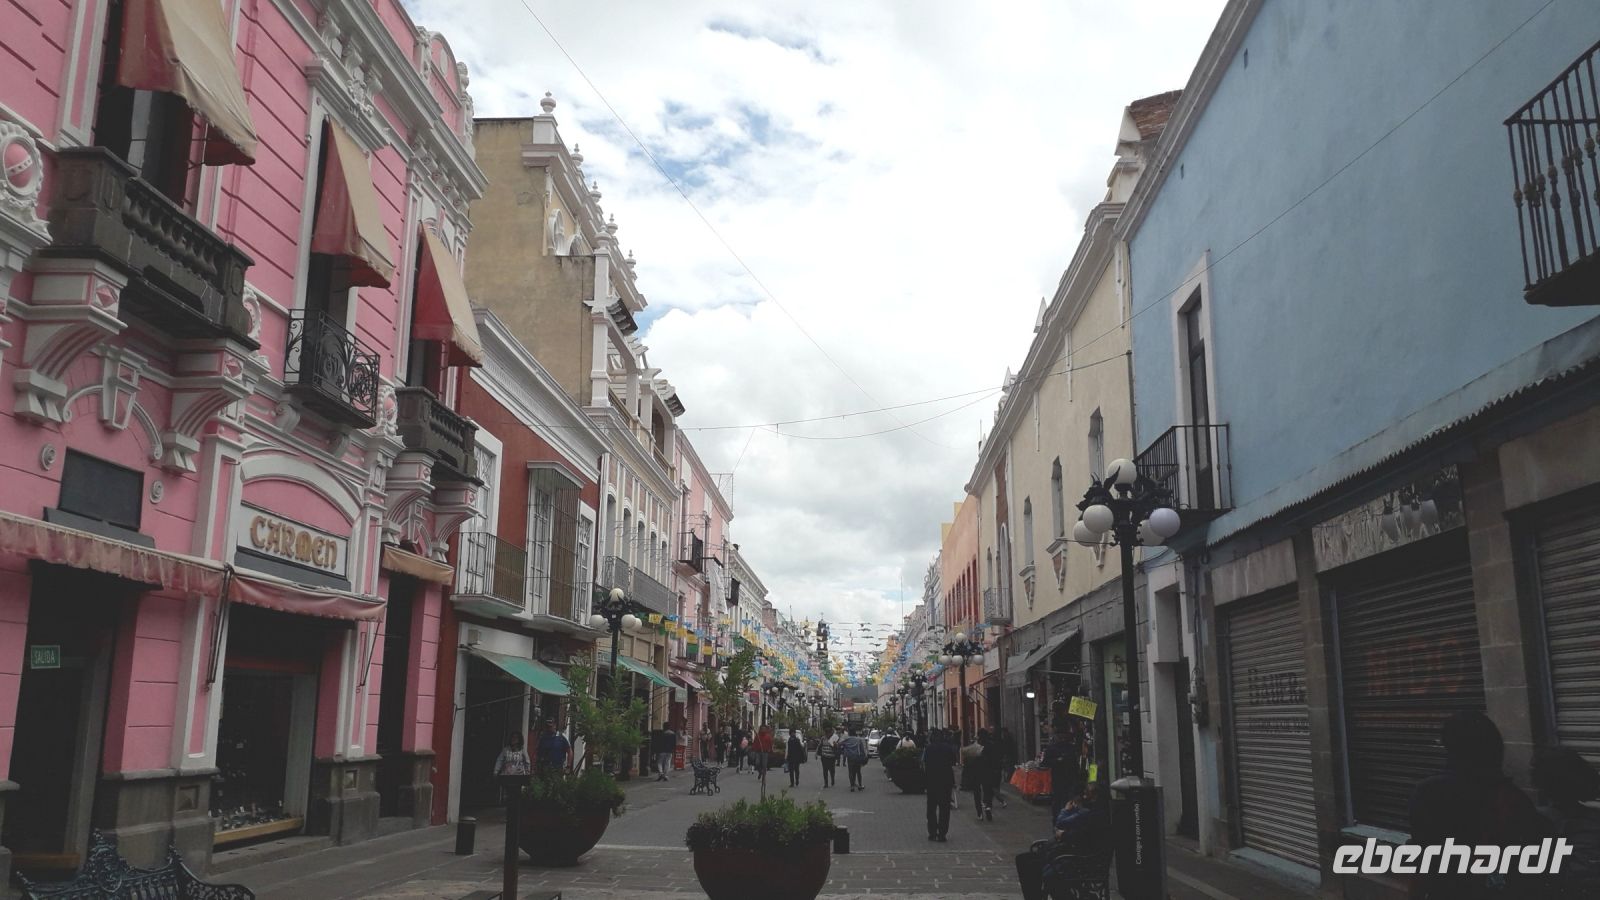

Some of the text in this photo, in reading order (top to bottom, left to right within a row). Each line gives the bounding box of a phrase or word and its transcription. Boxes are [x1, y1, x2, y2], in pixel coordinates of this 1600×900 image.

[250, 515, 338, 570] CARMEN
[34, 649, 56, 665] SALIDA
[1135, 841, 1143, 865] Contigo
